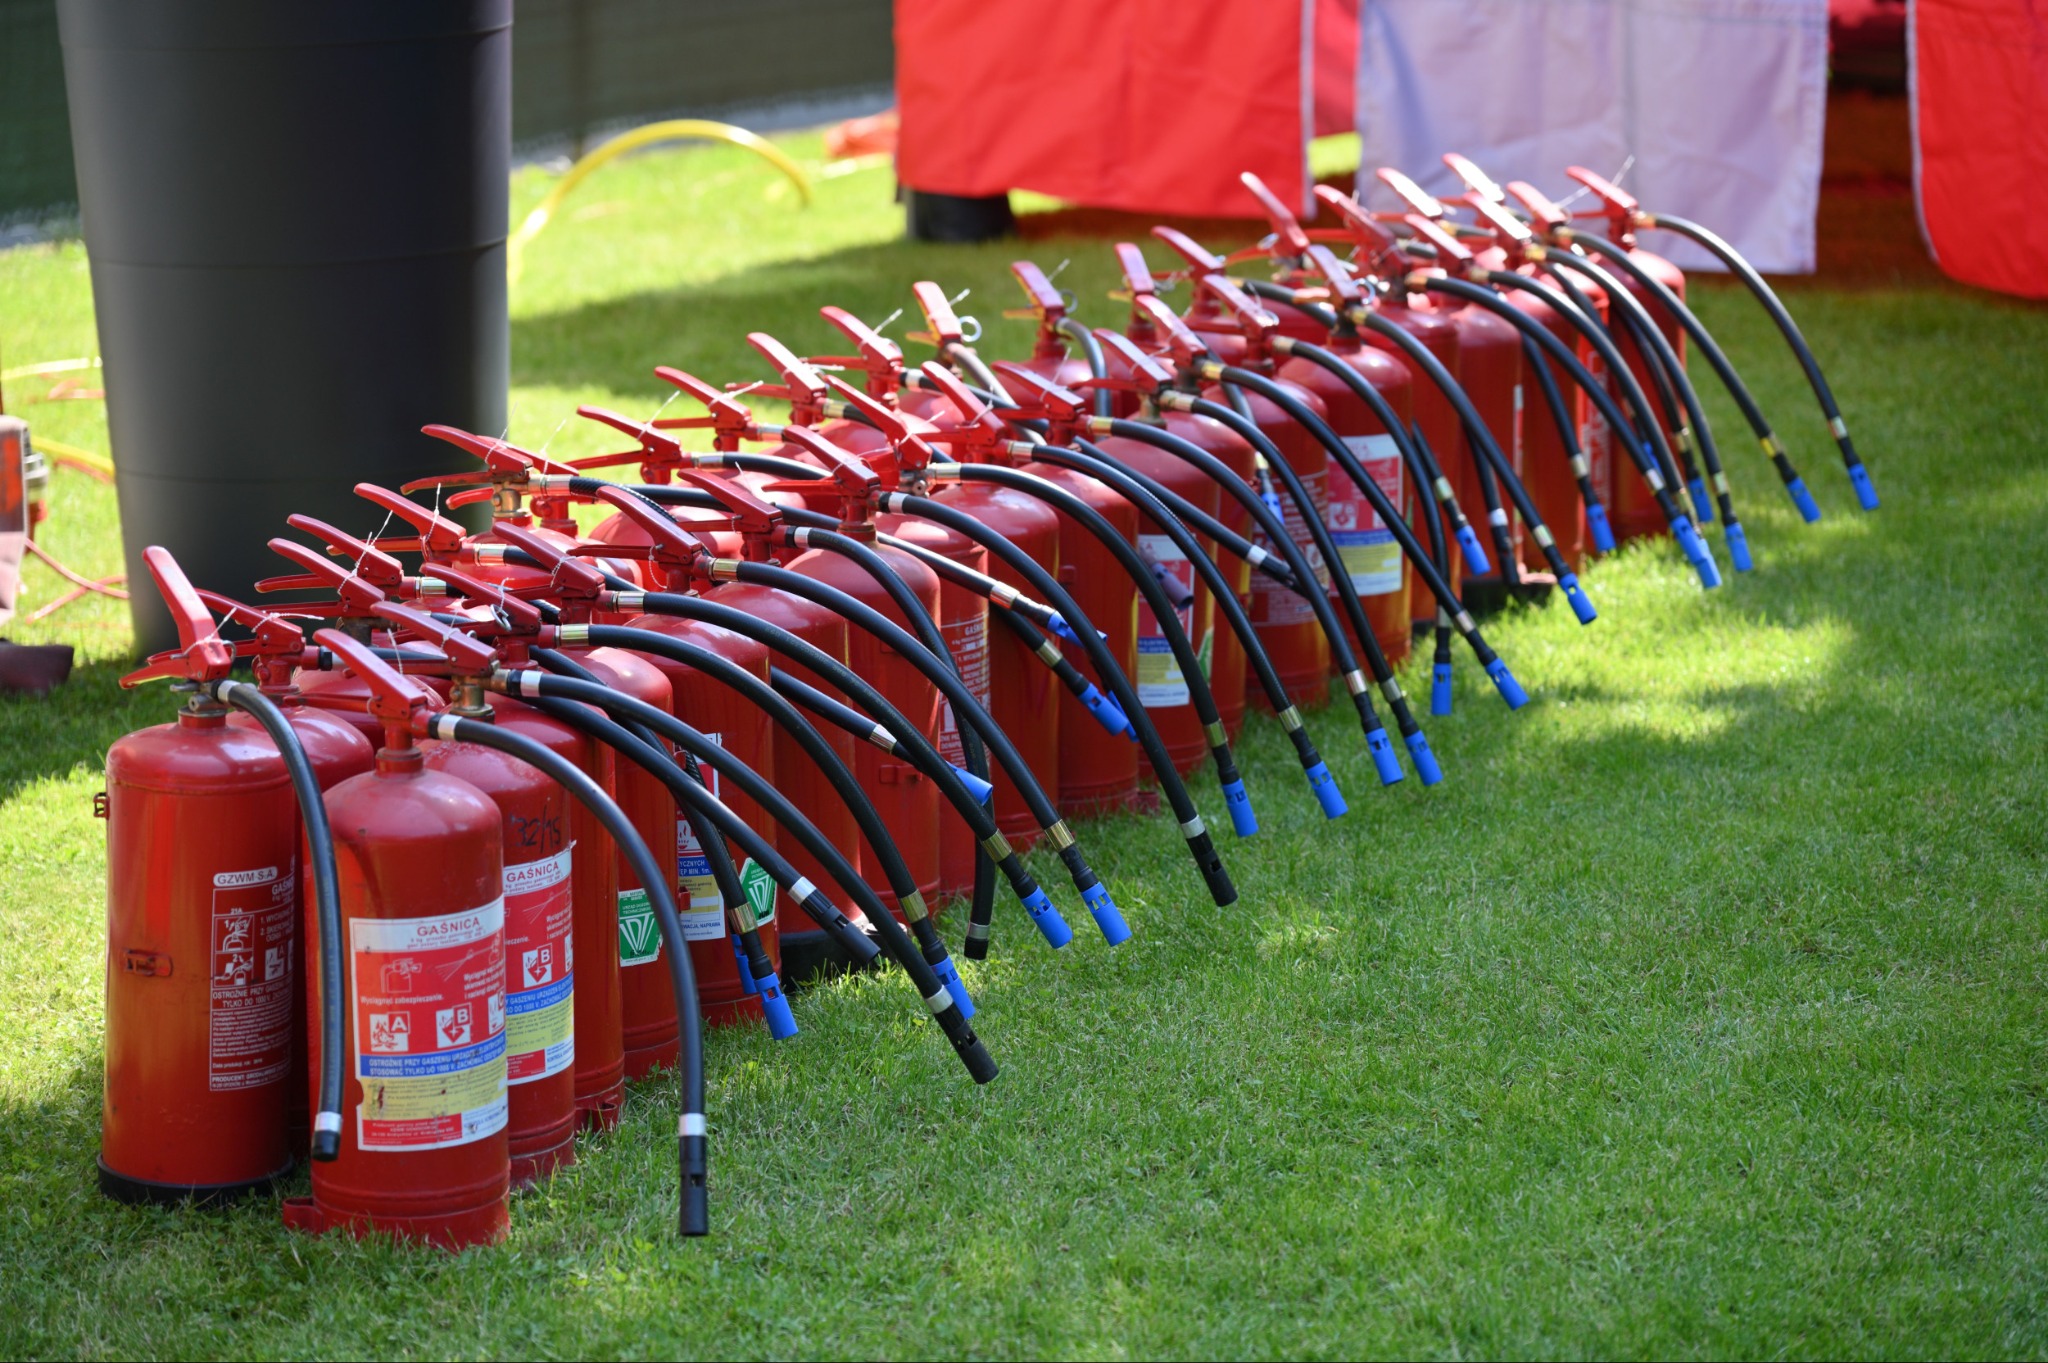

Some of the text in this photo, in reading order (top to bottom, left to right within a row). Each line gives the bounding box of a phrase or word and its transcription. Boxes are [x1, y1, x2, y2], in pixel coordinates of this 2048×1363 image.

[217, 872, 255, 885] GZWM
[506, 860, 559, 883] GAŚNICA
[416, 916, 481, 938] GAŚNICA
[541, 949, 550, 964] B
[212, 989, 249, 1000] OSTROŻNIE
[222, 999, 243, 1008] TYLKO
[244, 997, 254, 1006] DO
[457, 1008, 469, 1025] B
[390, 1016, 408, 1032] A
[369, 1058, 403, 1068] OSTROŻNIE
[404, 1057, 421, 1066] PRZY
[421, 1054, 452, 1065] GASZENIU
[369, 1066, 404, 1076] STOSOWAĆ
[404, 1065, 425, 1075] TYLKO
